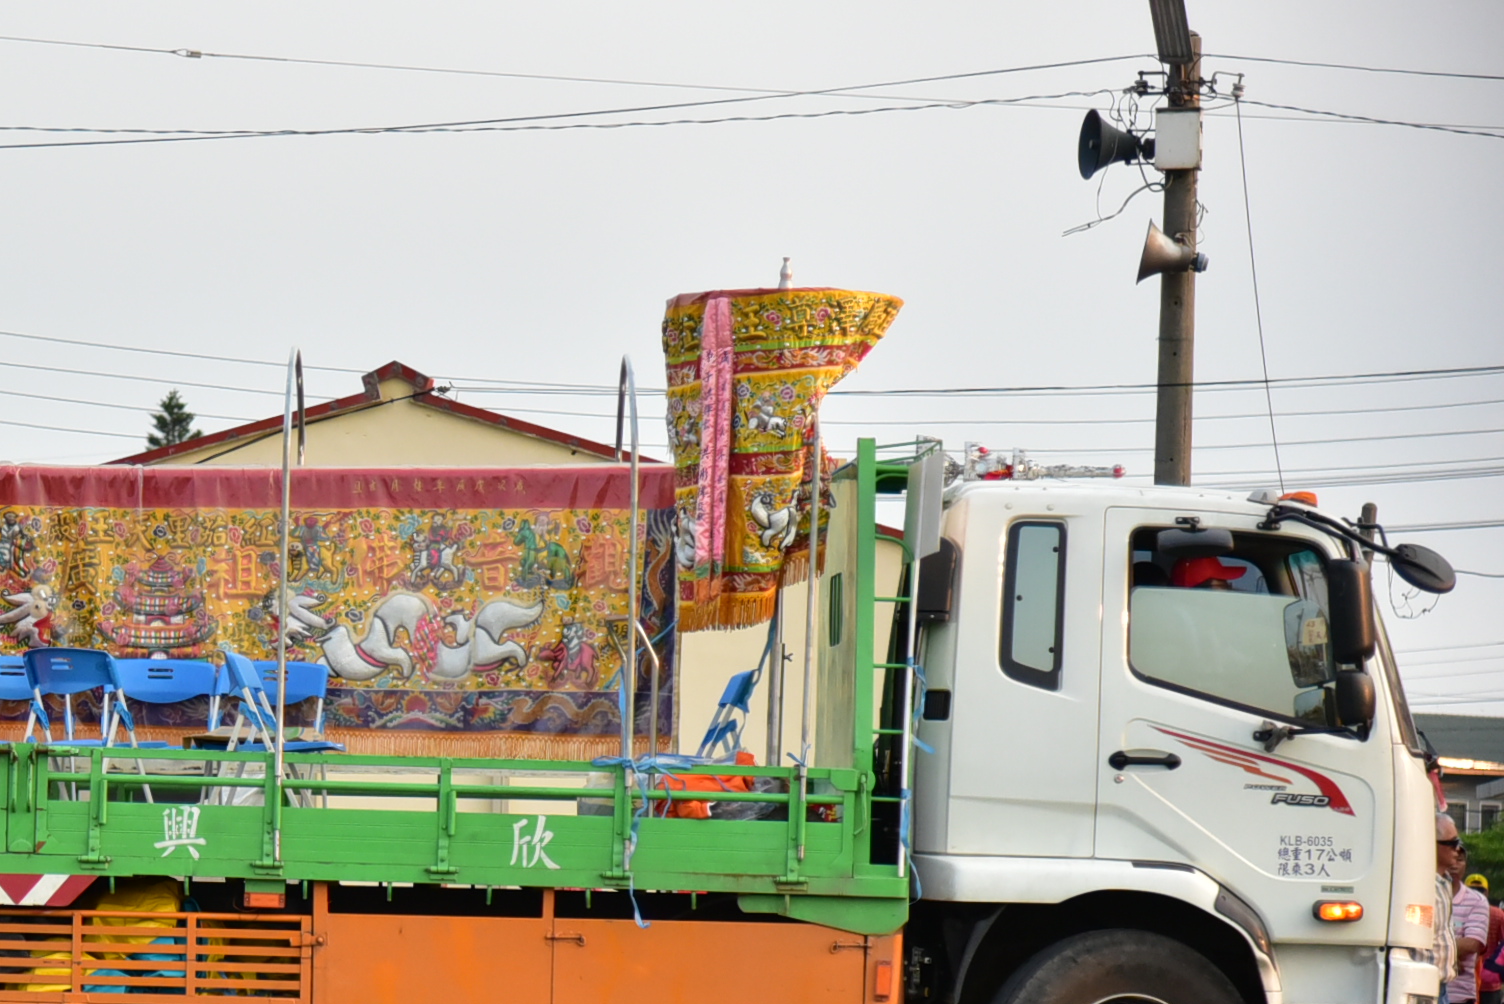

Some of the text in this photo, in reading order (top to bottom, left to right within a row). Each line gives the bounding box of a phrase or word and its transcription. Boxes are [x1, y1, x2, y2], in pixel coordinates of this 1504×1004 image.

[209, 549, 270, 599] 祖
[464, 531, 519, 591] 音
[1272, 793, 1330, 807] FUSO
[154, 806, 206, 861] 興
[509, 814, 561, 869] 欣
[1280, 835, 1333, 847] KLB-6035
[1278, 862, 1331, 877] 限乘3人
